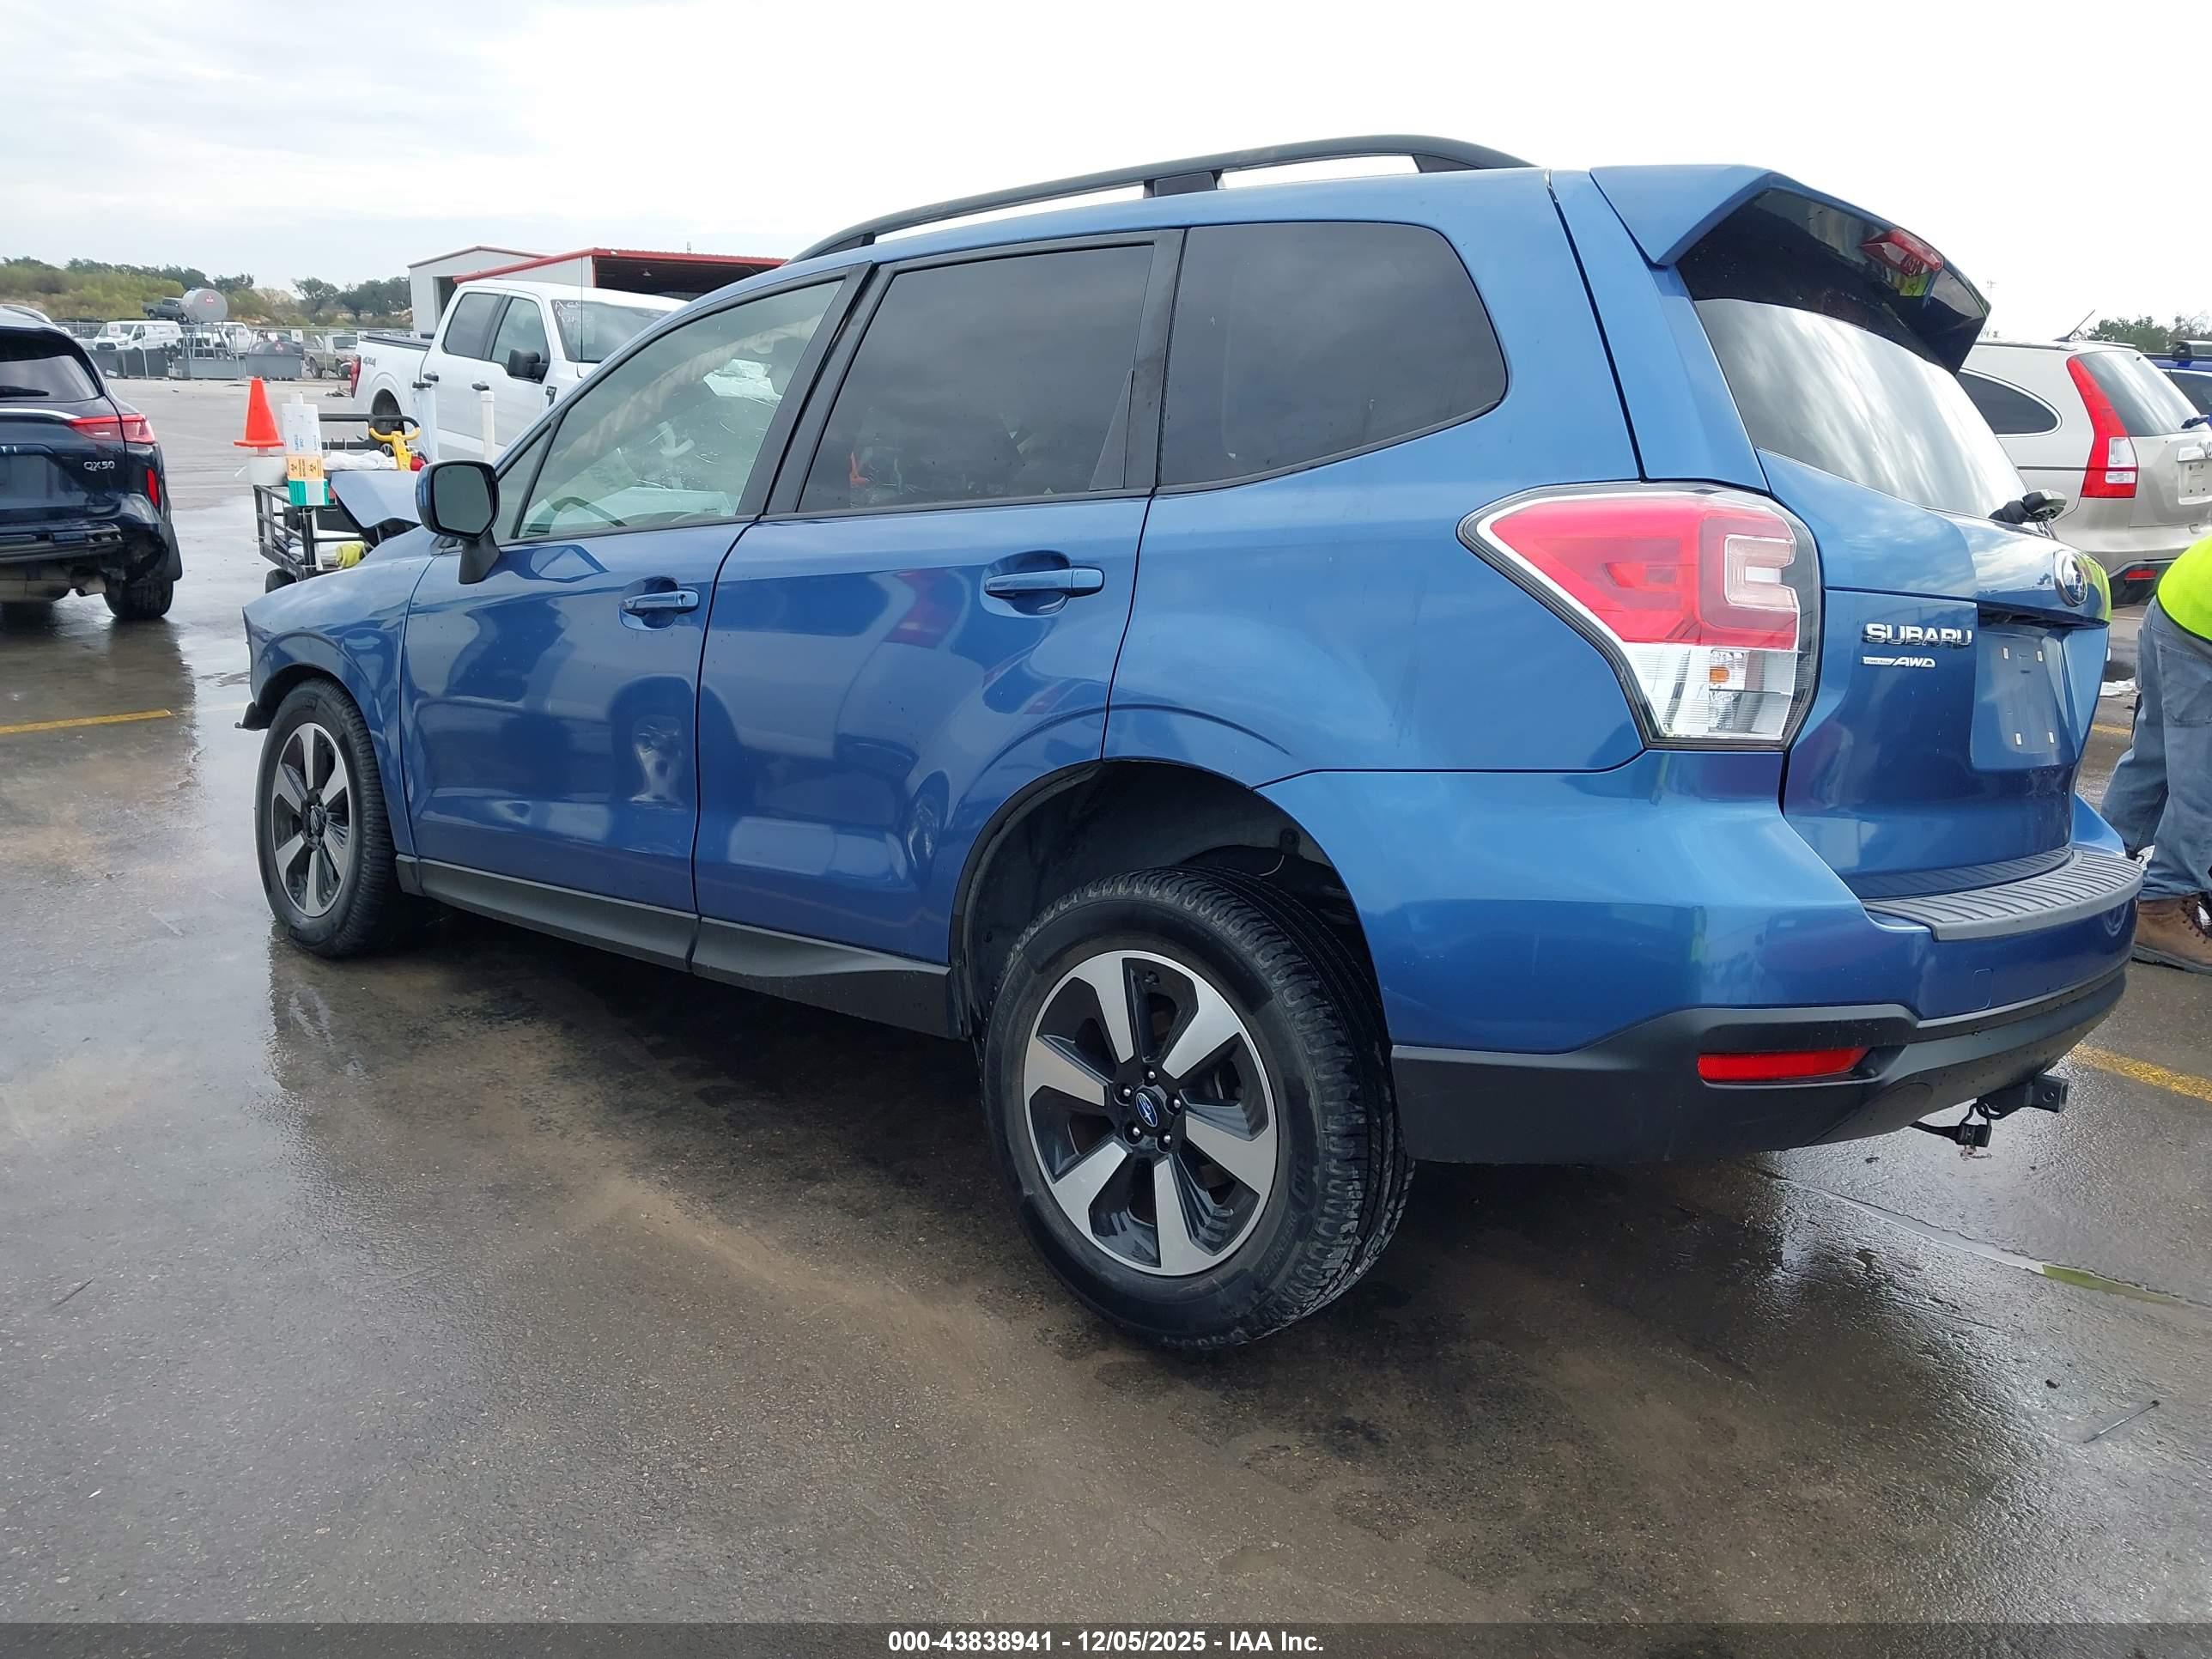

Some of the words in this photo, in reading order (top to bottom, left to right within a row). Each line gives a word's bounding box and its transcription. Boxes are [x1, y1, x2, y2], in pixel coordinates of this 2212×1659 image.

[83, 460, 116, 471] QX50
[1863, 623, 1973, 646] SUBARU
[1892, 656, 1936, 668] AWD
